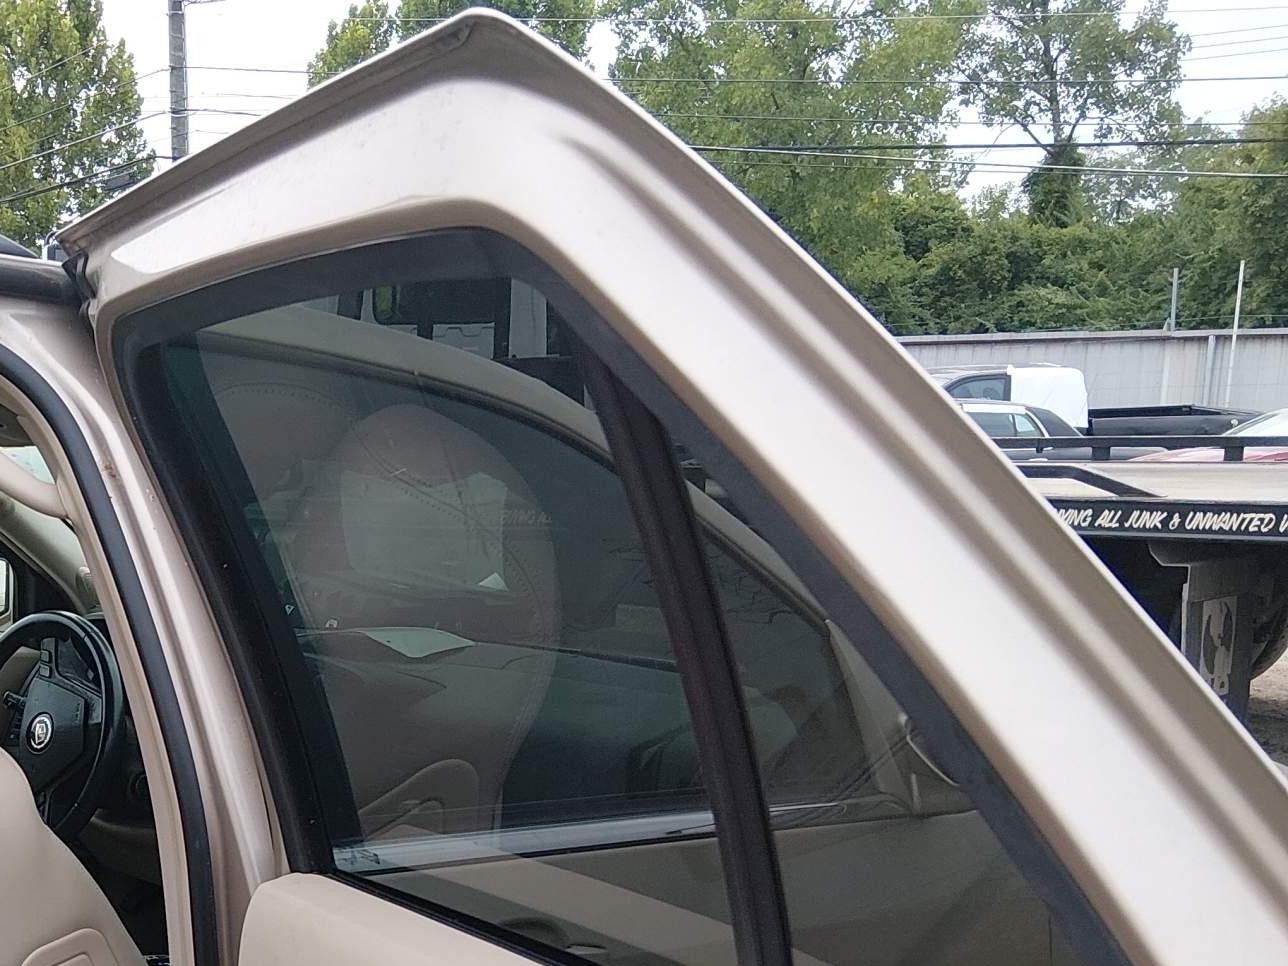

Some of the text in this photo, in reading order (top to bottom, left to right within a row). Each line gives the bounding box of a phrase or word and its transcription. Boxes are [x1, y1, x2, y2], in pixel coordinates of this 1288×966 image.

[1094, 509, 1122, 528] ALL
[1124, 510, 1168, 530] JUNK
[1169, 512, 1181, 529] &
[1184, 511, 1276, 533] UNWANTED
